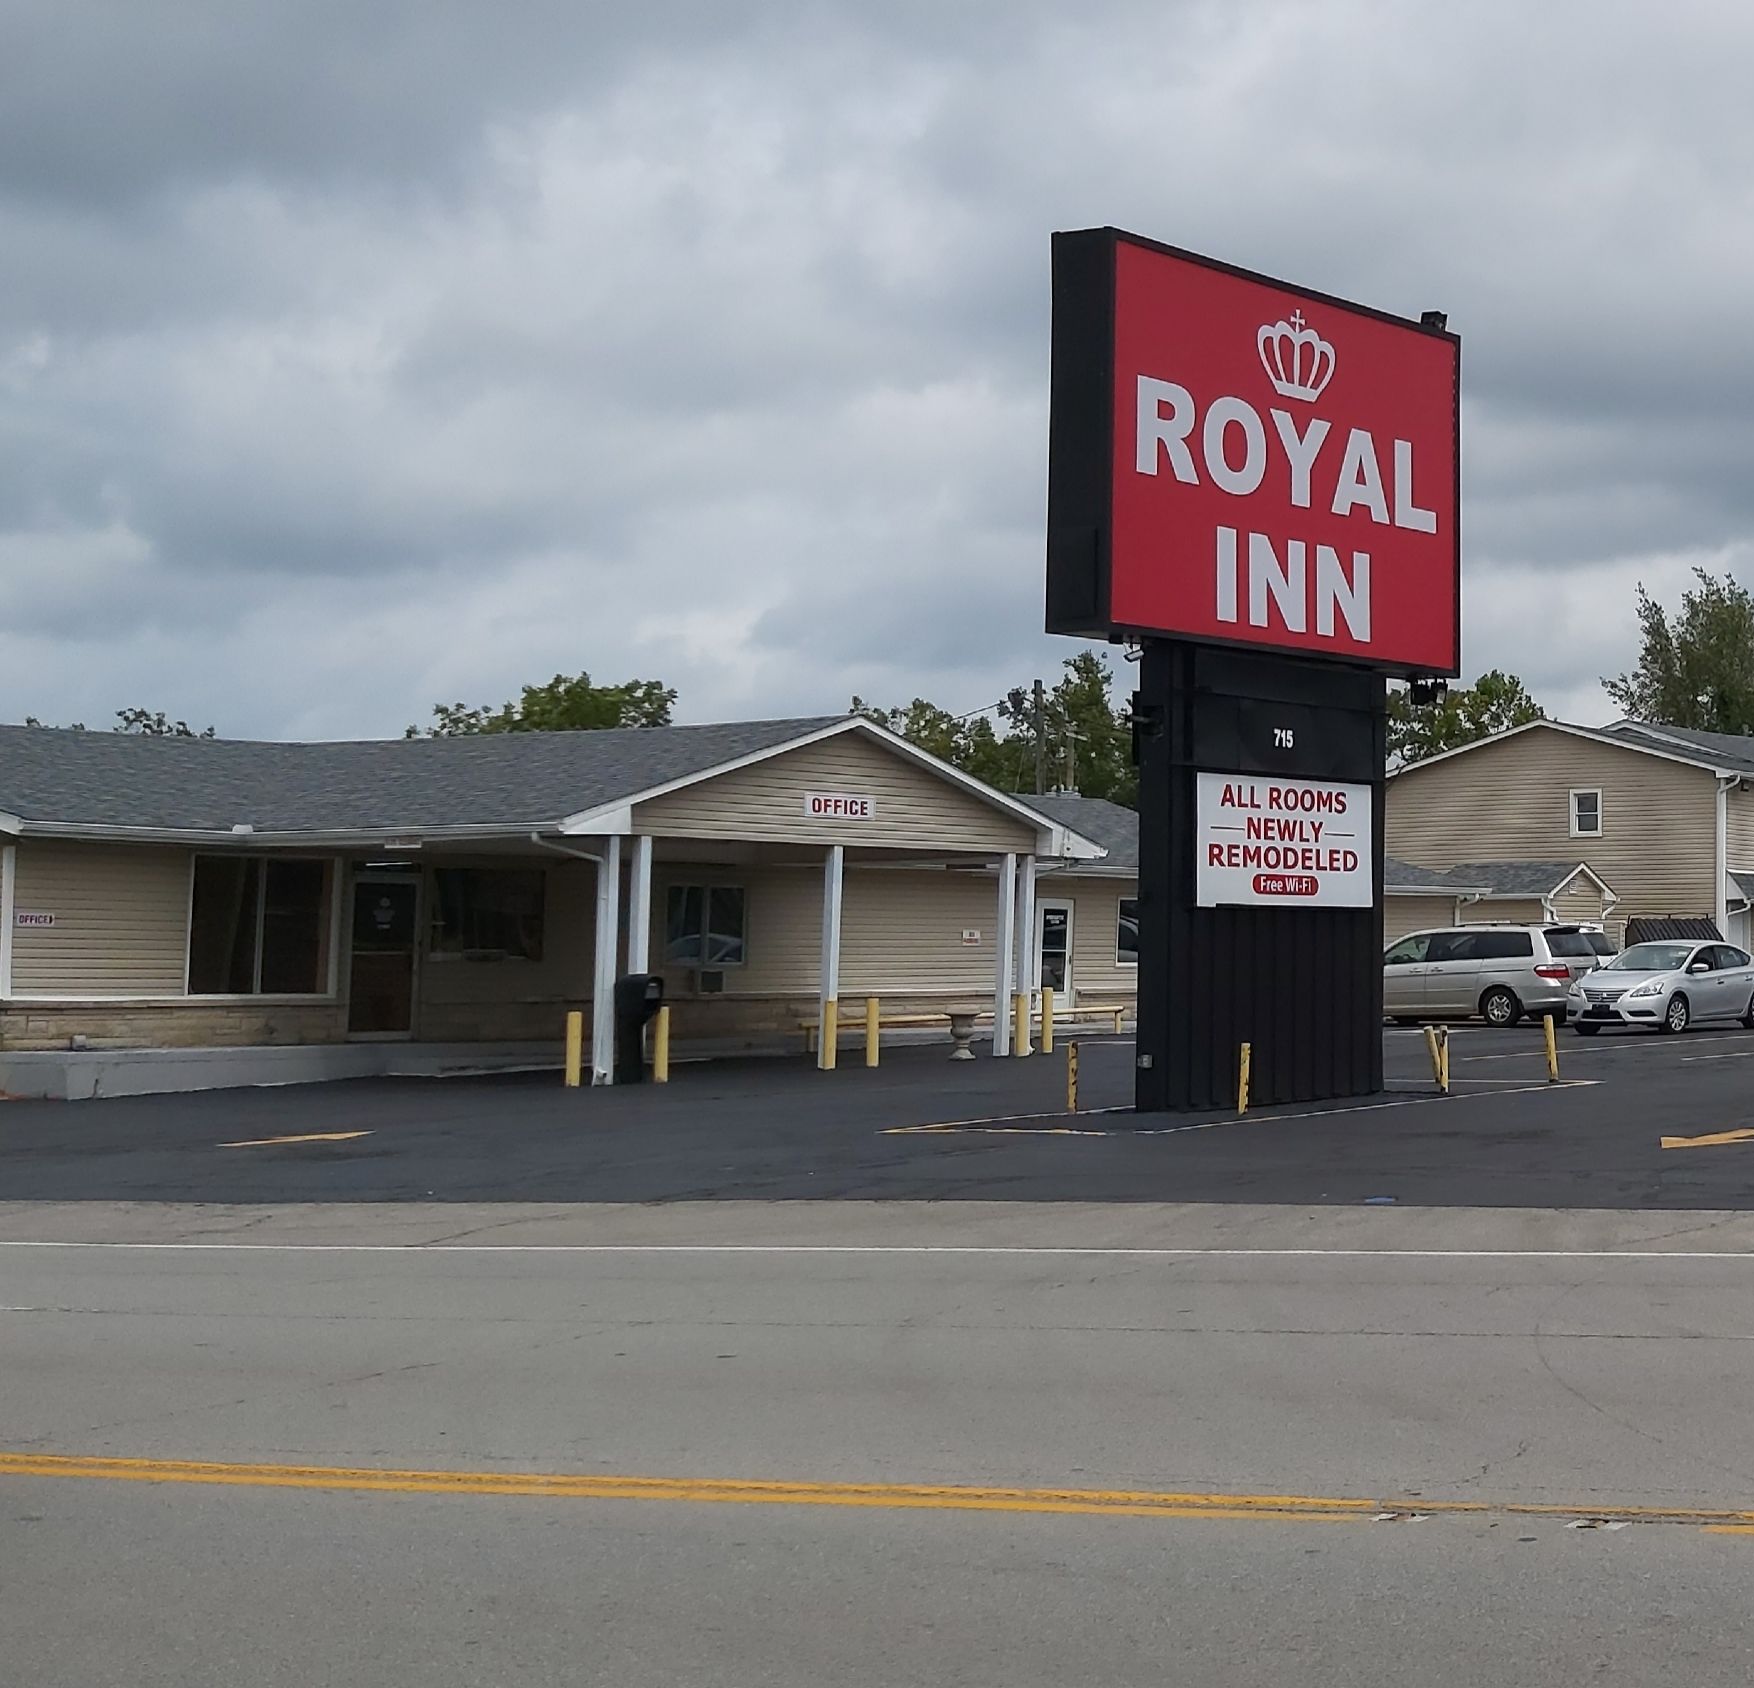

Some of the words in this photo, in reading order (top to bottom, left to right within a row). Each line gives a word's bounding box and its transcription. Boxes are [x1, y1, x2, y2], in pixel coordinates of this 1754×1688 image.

[1136, 374, 1437, 534] ROYAL
[1216, 525, 1371, 643] INN
[1273, 728, 1294, 749] 715
[812, 797, 868, 816] OFFICE
[1220, 784, 1262, 809] ALL
[1269, 787, 1347, 814] ROOMS
[1246, 816, 1324, 843] NEWLY
[1208, 843, 1359, 872] REMODELED
[1260, 876, 1284, 892] Free
[1285, 878, 1312, 893] Wi-Fi
[19, 914, 49, 924] OFFICE
